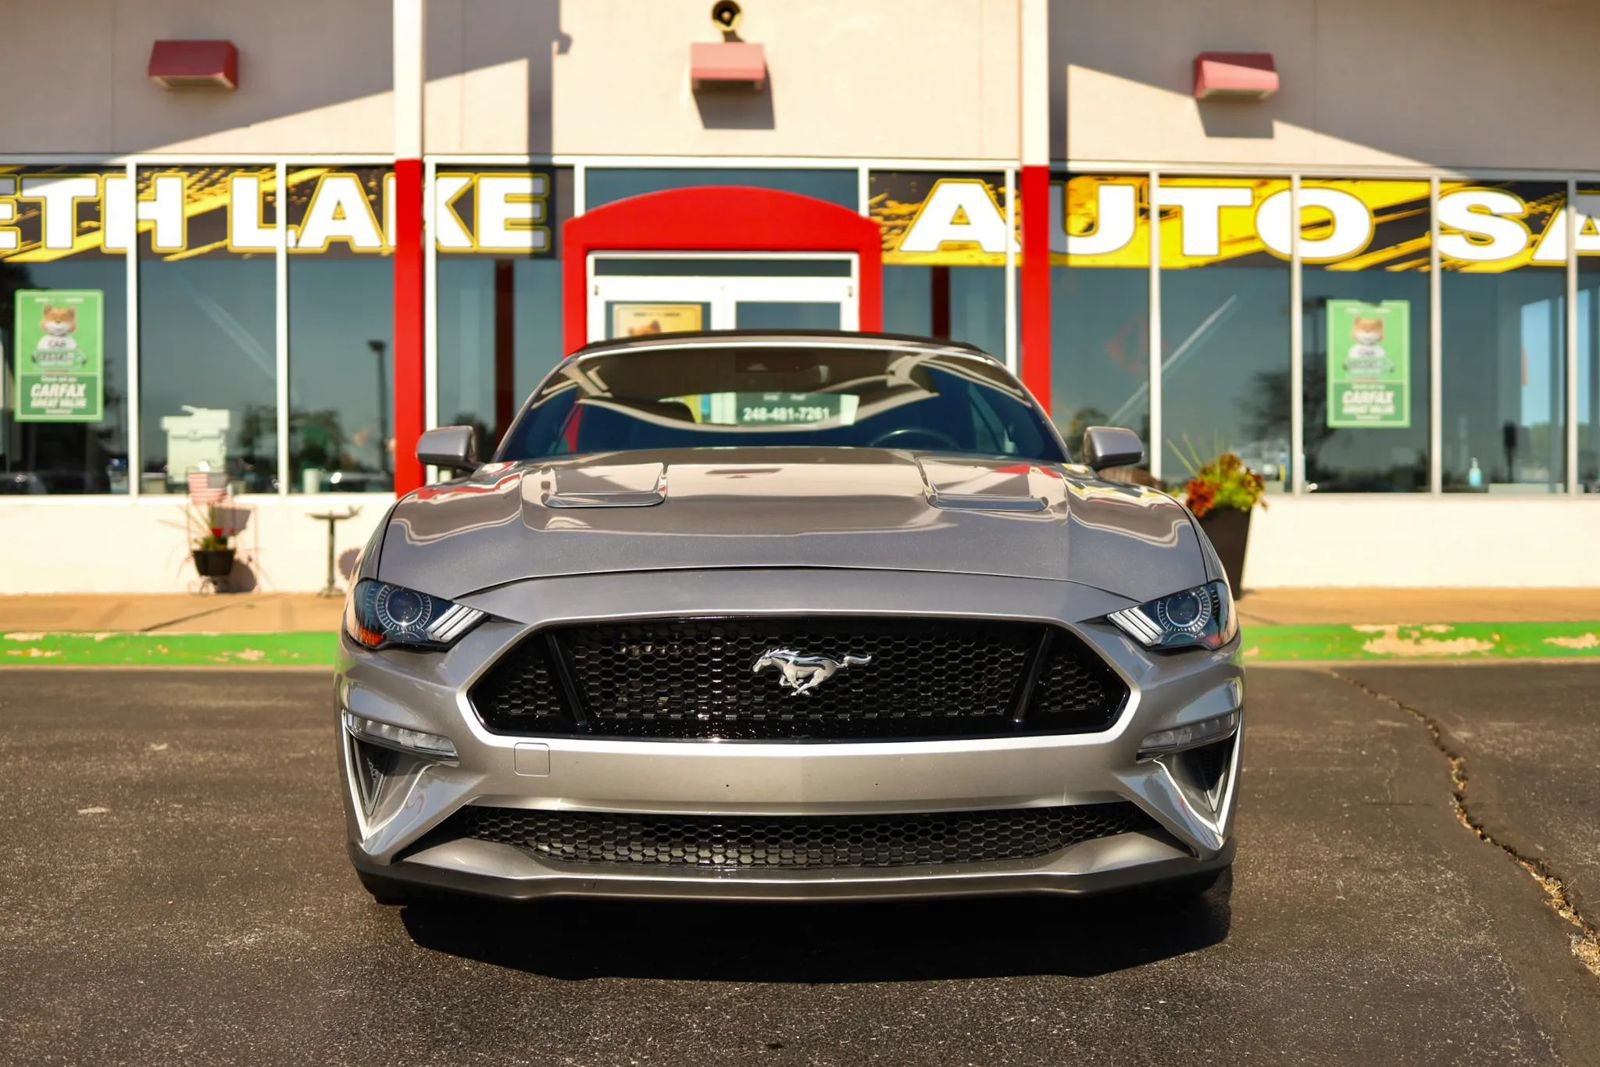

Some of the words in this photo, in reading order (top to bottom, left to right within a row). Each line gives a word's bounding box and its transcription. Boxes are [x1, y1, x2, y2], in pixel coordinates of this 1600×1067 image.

[0, 173, 187, 253] TH
[227, 173, 549, 253] LAKE
[898, 178, 1375, 264] AUTO
[30, 383, 87, 398] CARFAX
[1342, 391, 1395, 404] CARFAX
